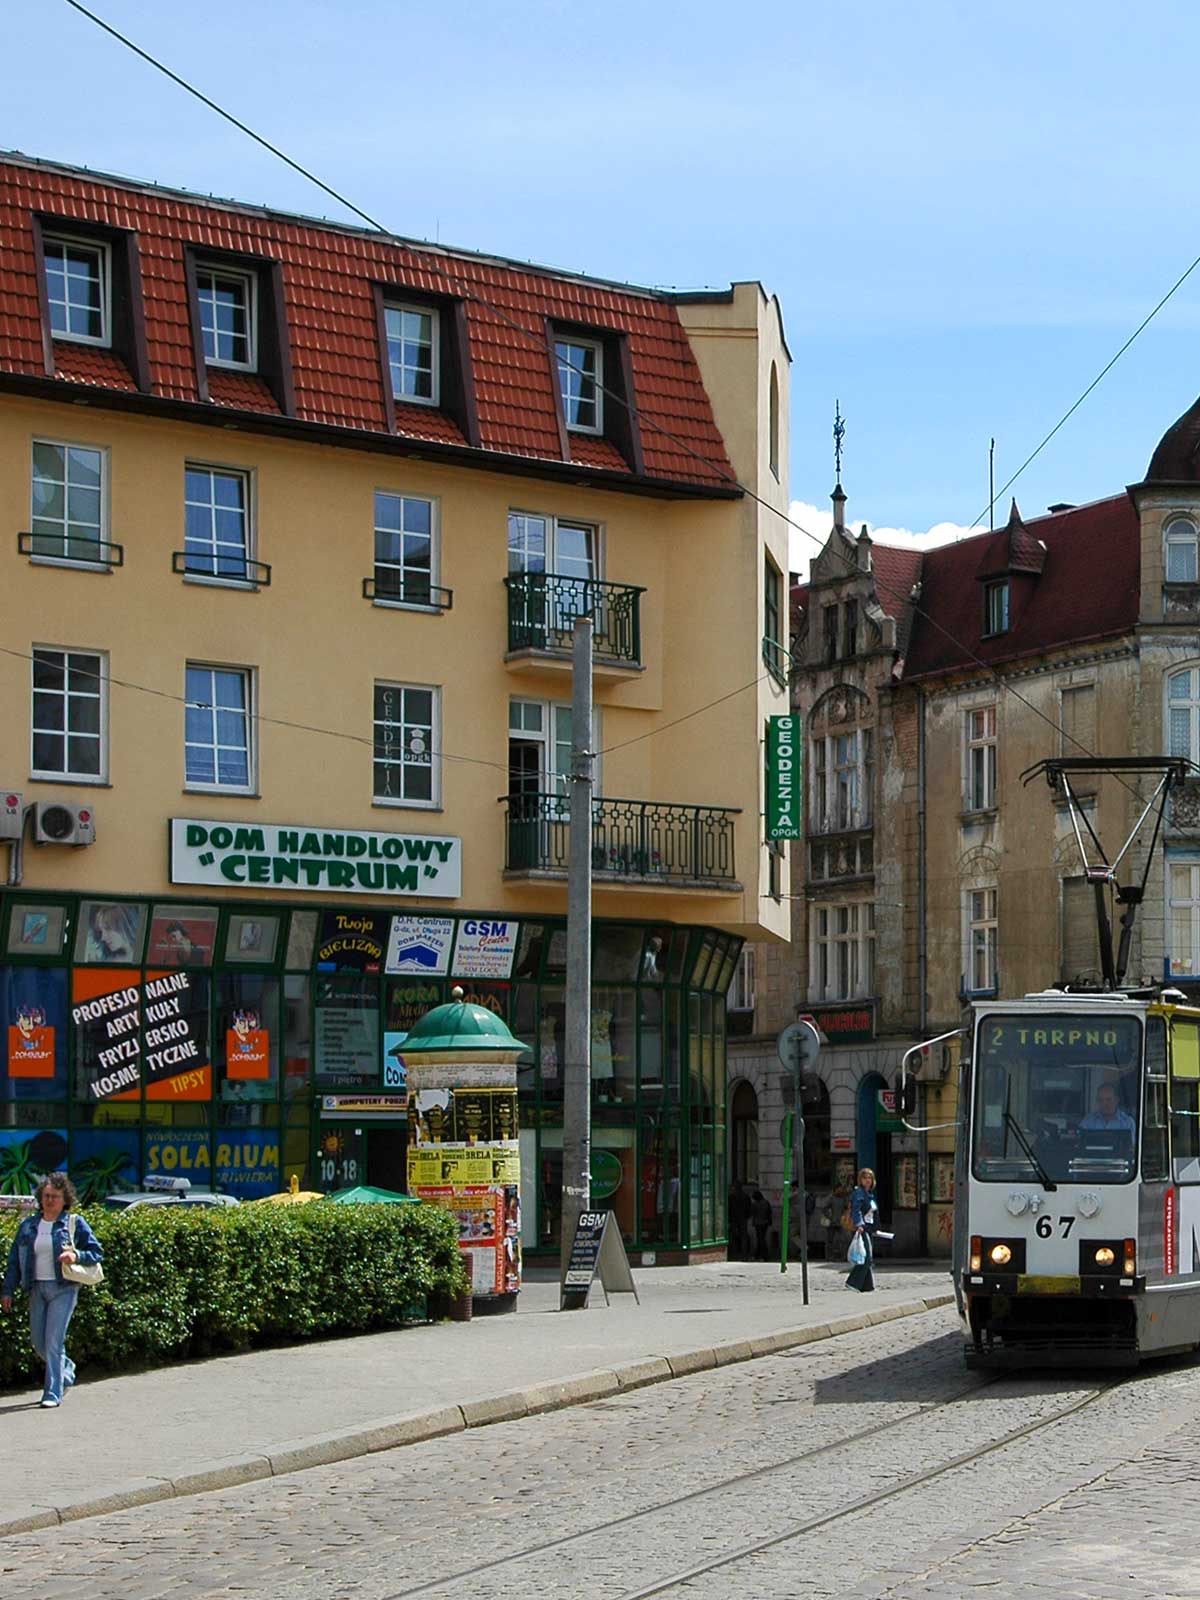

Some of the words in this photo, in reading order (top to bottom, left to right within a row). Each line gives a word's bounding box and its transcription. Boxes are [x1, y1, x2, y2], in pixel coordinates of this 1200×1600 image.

[777, 717, 793, 827] GEODEZJA
[771, 828, 799, 838] OPGK
[186, 825, 266, 851] DOM
[278, 831, 453, 863] HANDLOWY
[336, 915, 374, 934] Twoja
[464, 920, 508, 937] GSM
[319, 939, 382, 960] BIELIZNA
[991, 1026, 1004, 1046] 2
[1018, 1029, 1118, 1046] TARPNO
[170, 1071, 205, 1093] TIPSY
[147, 1144, 280, 1170] SOLARIUM
[579, 1213, 606, 1227] GSM
[1035, 1214, 1076, 1239] 67
